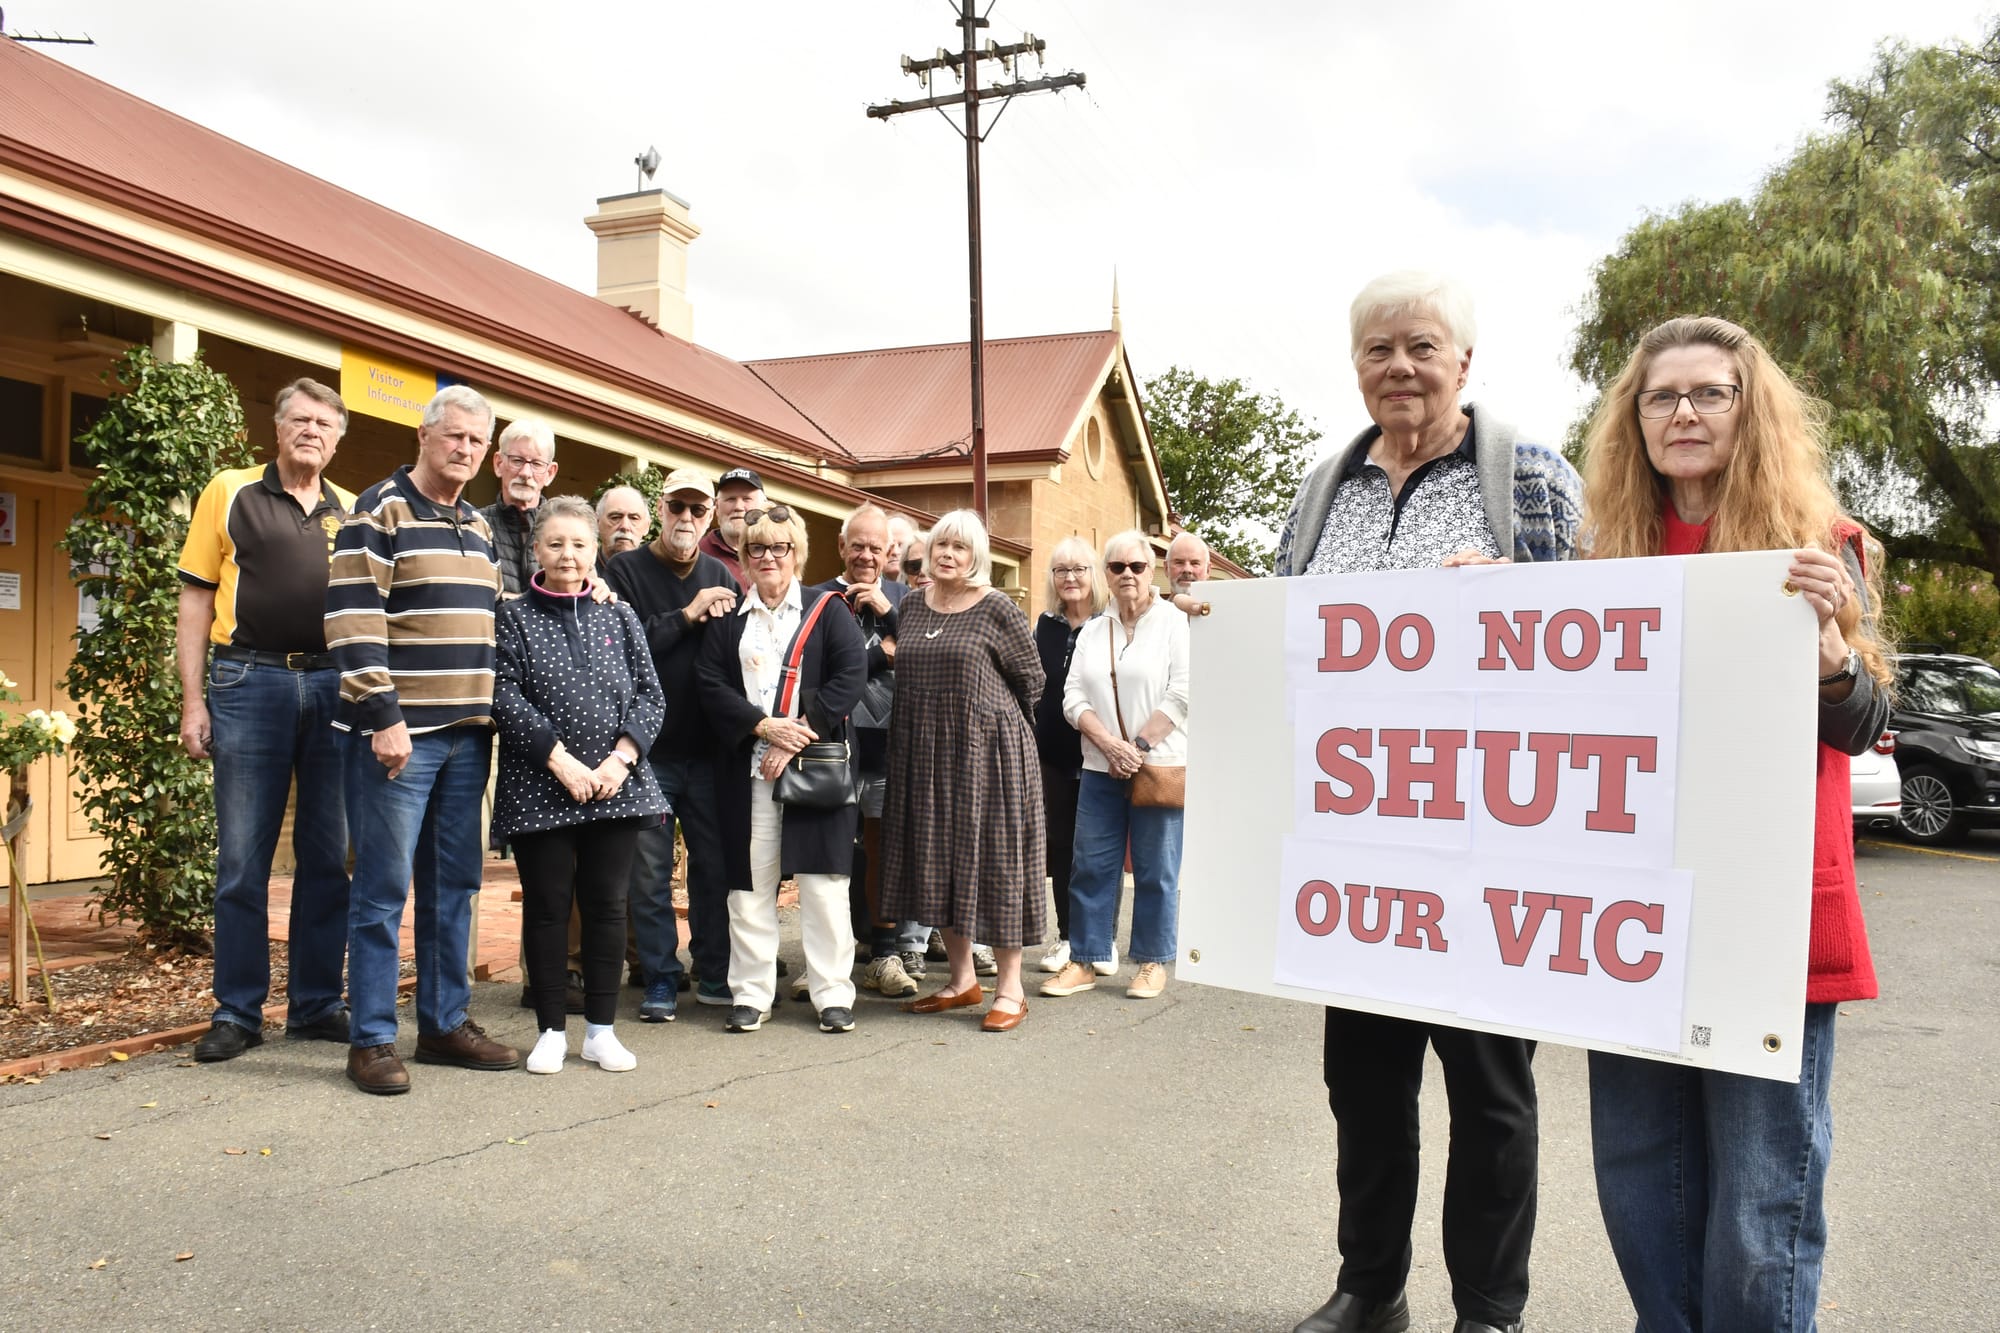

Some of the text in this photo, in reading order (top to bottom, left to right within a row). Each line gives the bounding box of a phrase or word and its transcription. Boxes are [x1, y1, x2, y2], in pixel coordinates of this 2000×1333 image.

[368, 366, 405, 388] Visitor
[1477, 607, 1662, 672] NOT
[1314, 726, 1658, 834] SHUT
[1295, 879, 1665, 983] OUR VIC
